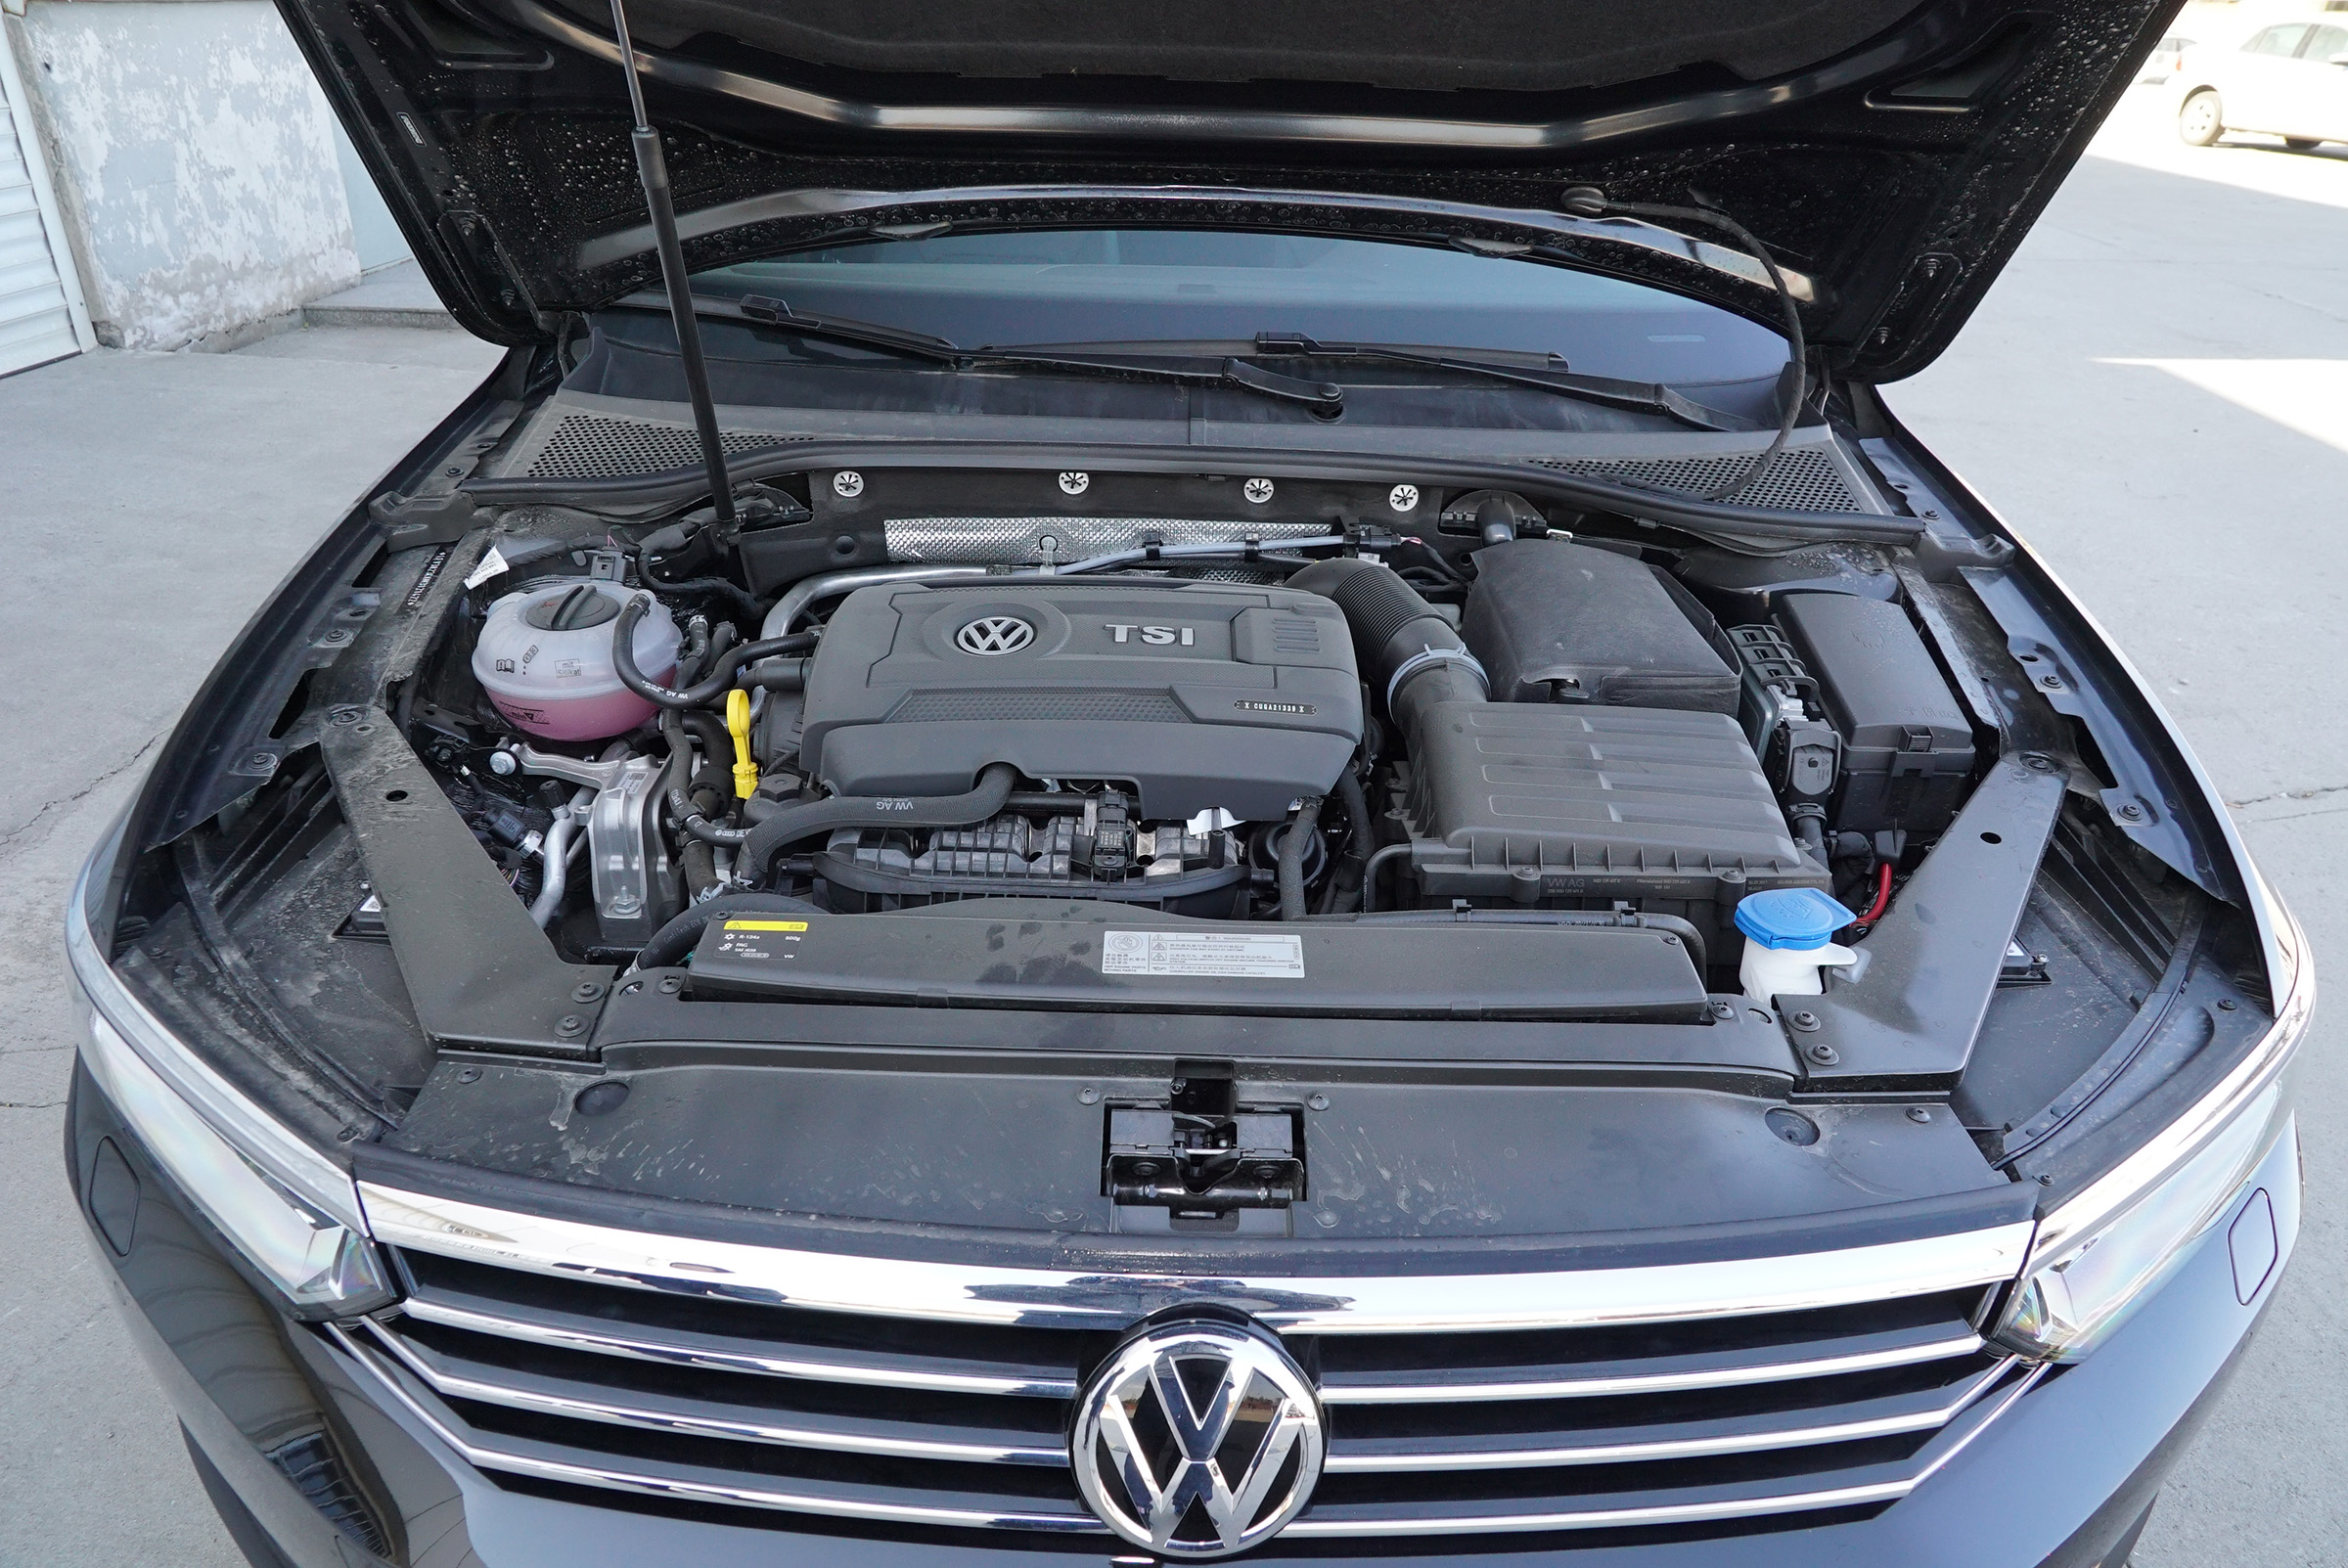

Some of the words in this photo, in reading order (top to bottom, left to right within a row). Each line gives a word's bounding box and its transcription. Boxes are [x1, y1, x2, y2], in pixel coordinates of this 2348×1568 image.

[1105, 624, 1195, 647] TSI
[558, 668, 581, 677] Silikat
[876, 801, 893, 811] AG
[894, 801, 914, 811] VW
[1547, 877, 1567, 888] VW
[1567, 877, 1585, 888] AG
